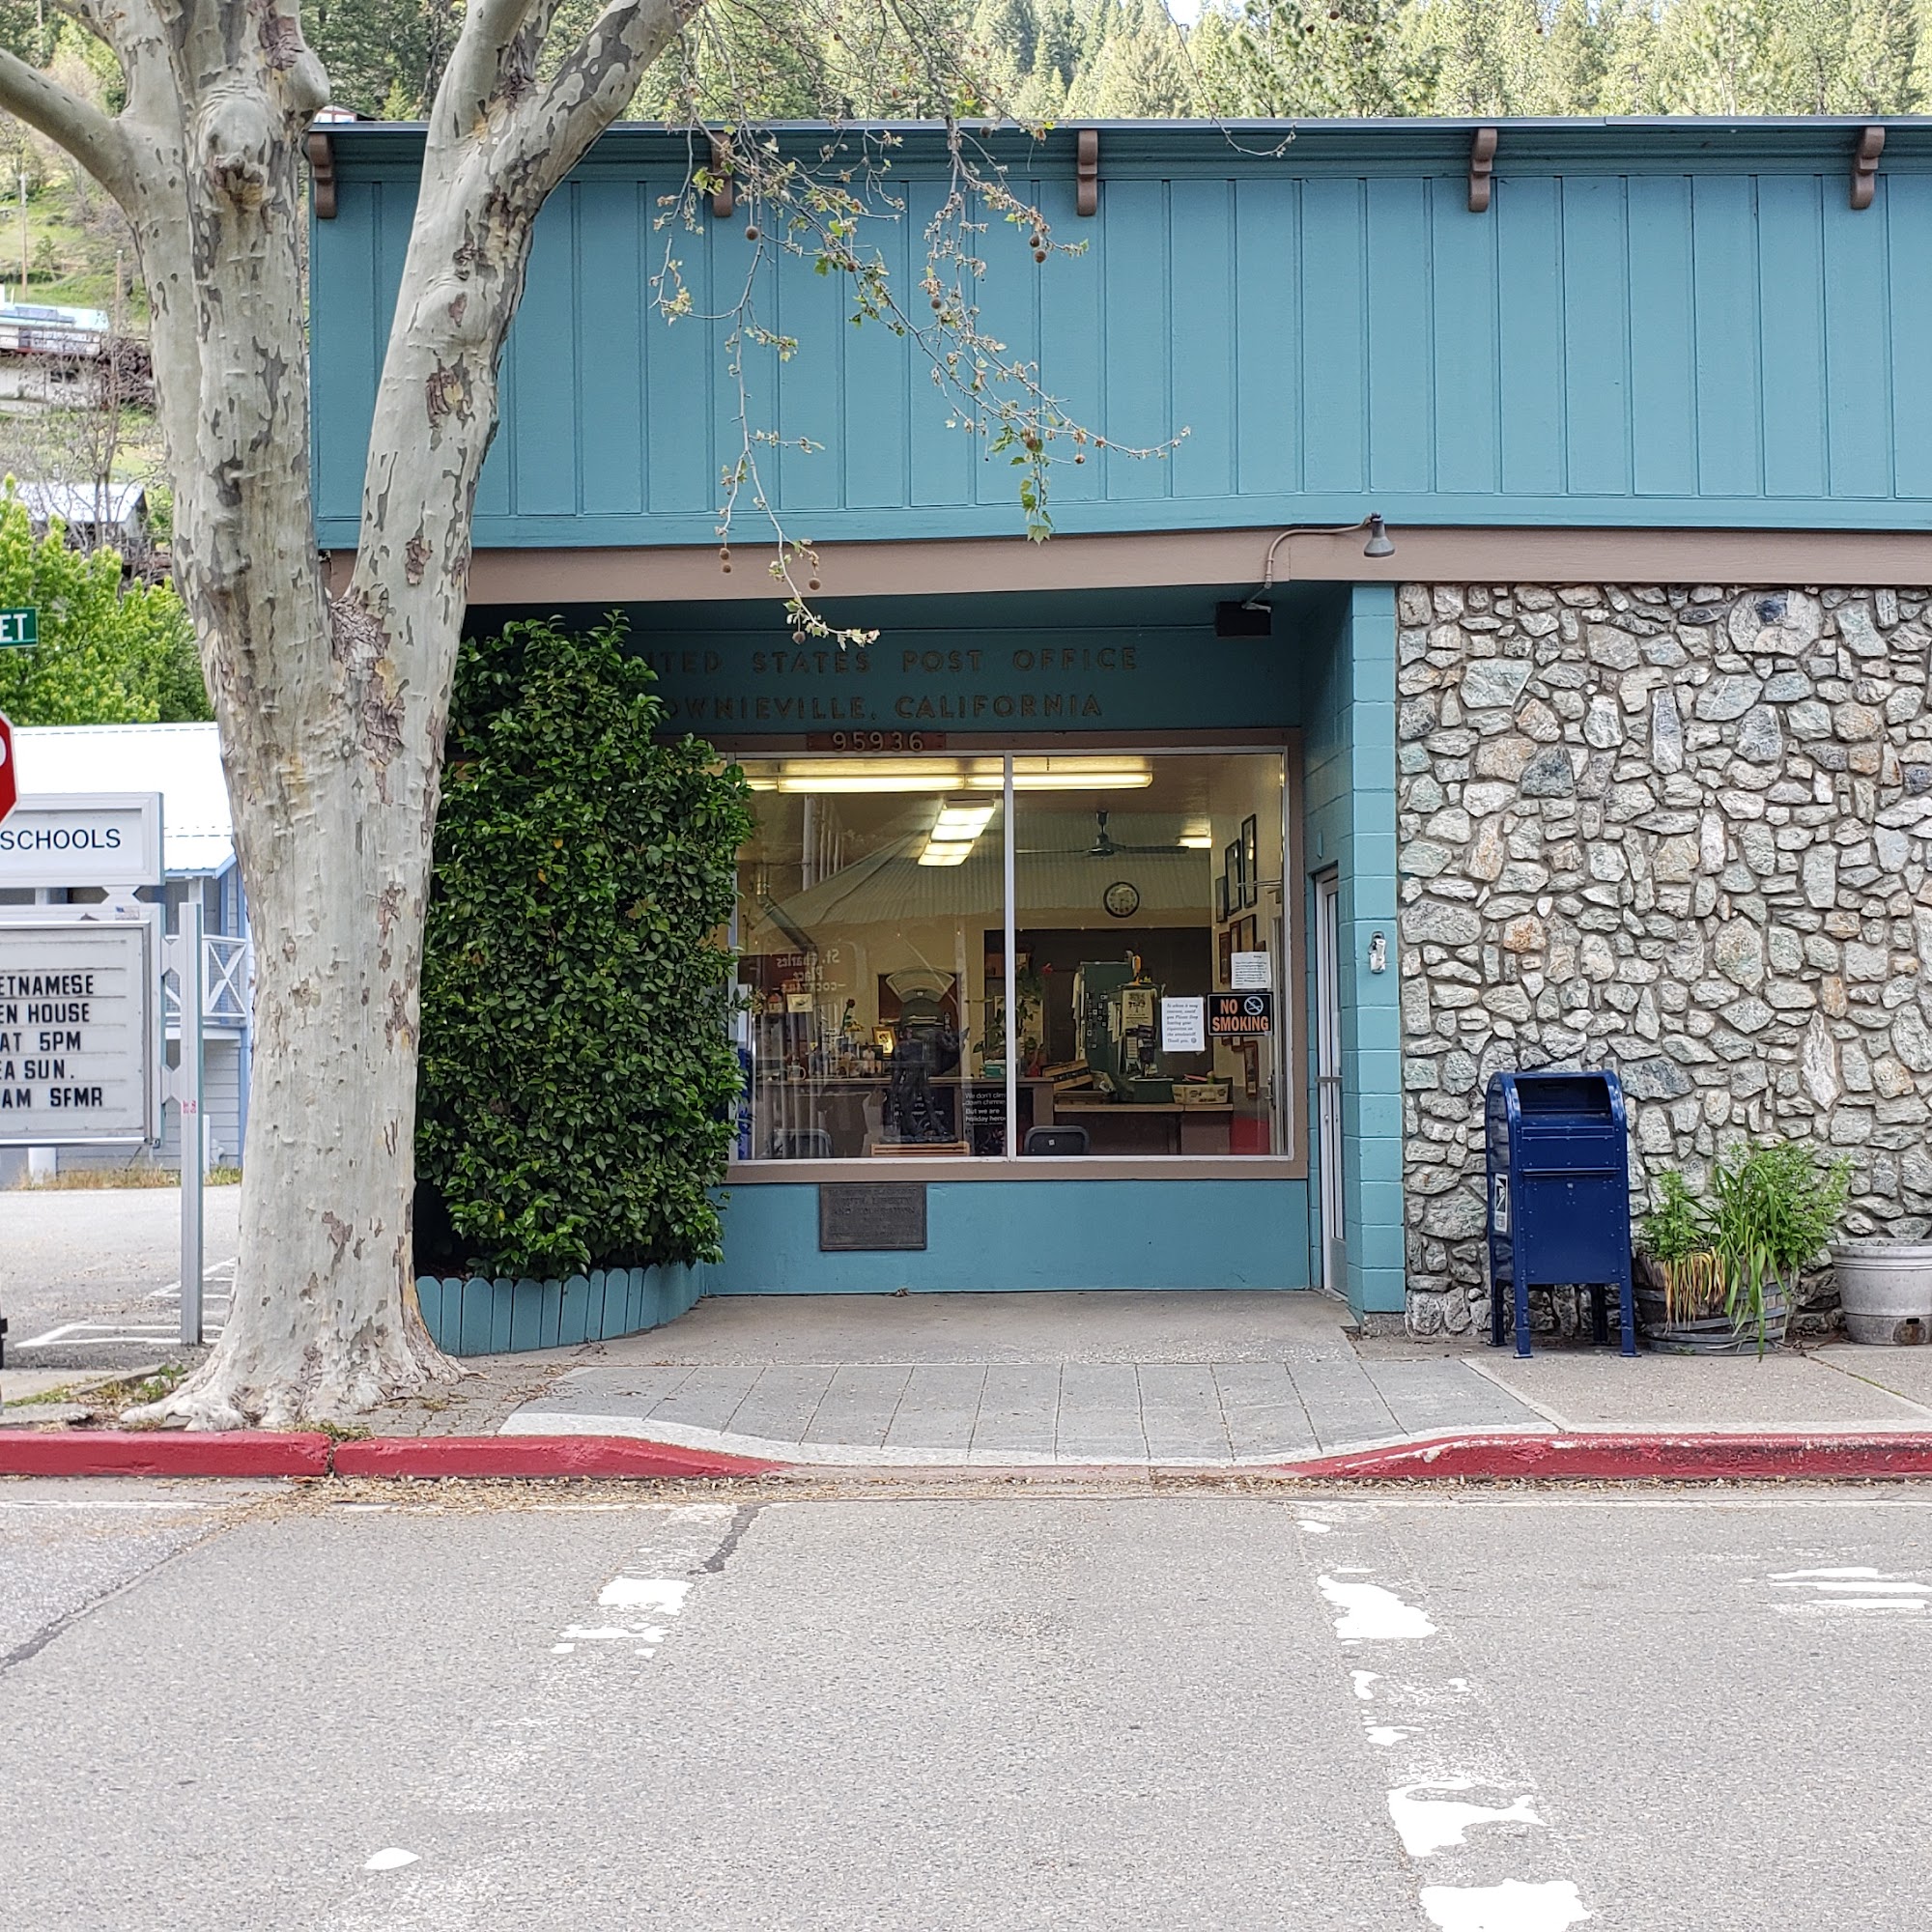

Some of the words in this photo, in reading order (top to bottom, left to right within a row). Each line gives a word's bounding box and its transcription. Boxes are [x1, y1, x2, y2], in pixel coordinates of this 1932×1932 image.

[753, 650, 871, 673] STATES
[902, 649, 983, 672] POST
[1012, 647, 1138, 671] OFFICE
[895, 694, 1102, 719] CALIFORNIA
[832, 730, 924, 752] 95936
[0, 828, 122, 851] SCHOOLS
[28, 1003, 90, 1024] HOUSE
[1220, 999, 1238, 1014] NO
[1212, 1016, 1269, 1032] SMOKING
[40, 1031, 81, 1051] 5PM
[24, 1059, 74, 1079] SUN.
[2, 1088, 31, 1109] AM
[50, 1087, 102, 1108] SFMR
